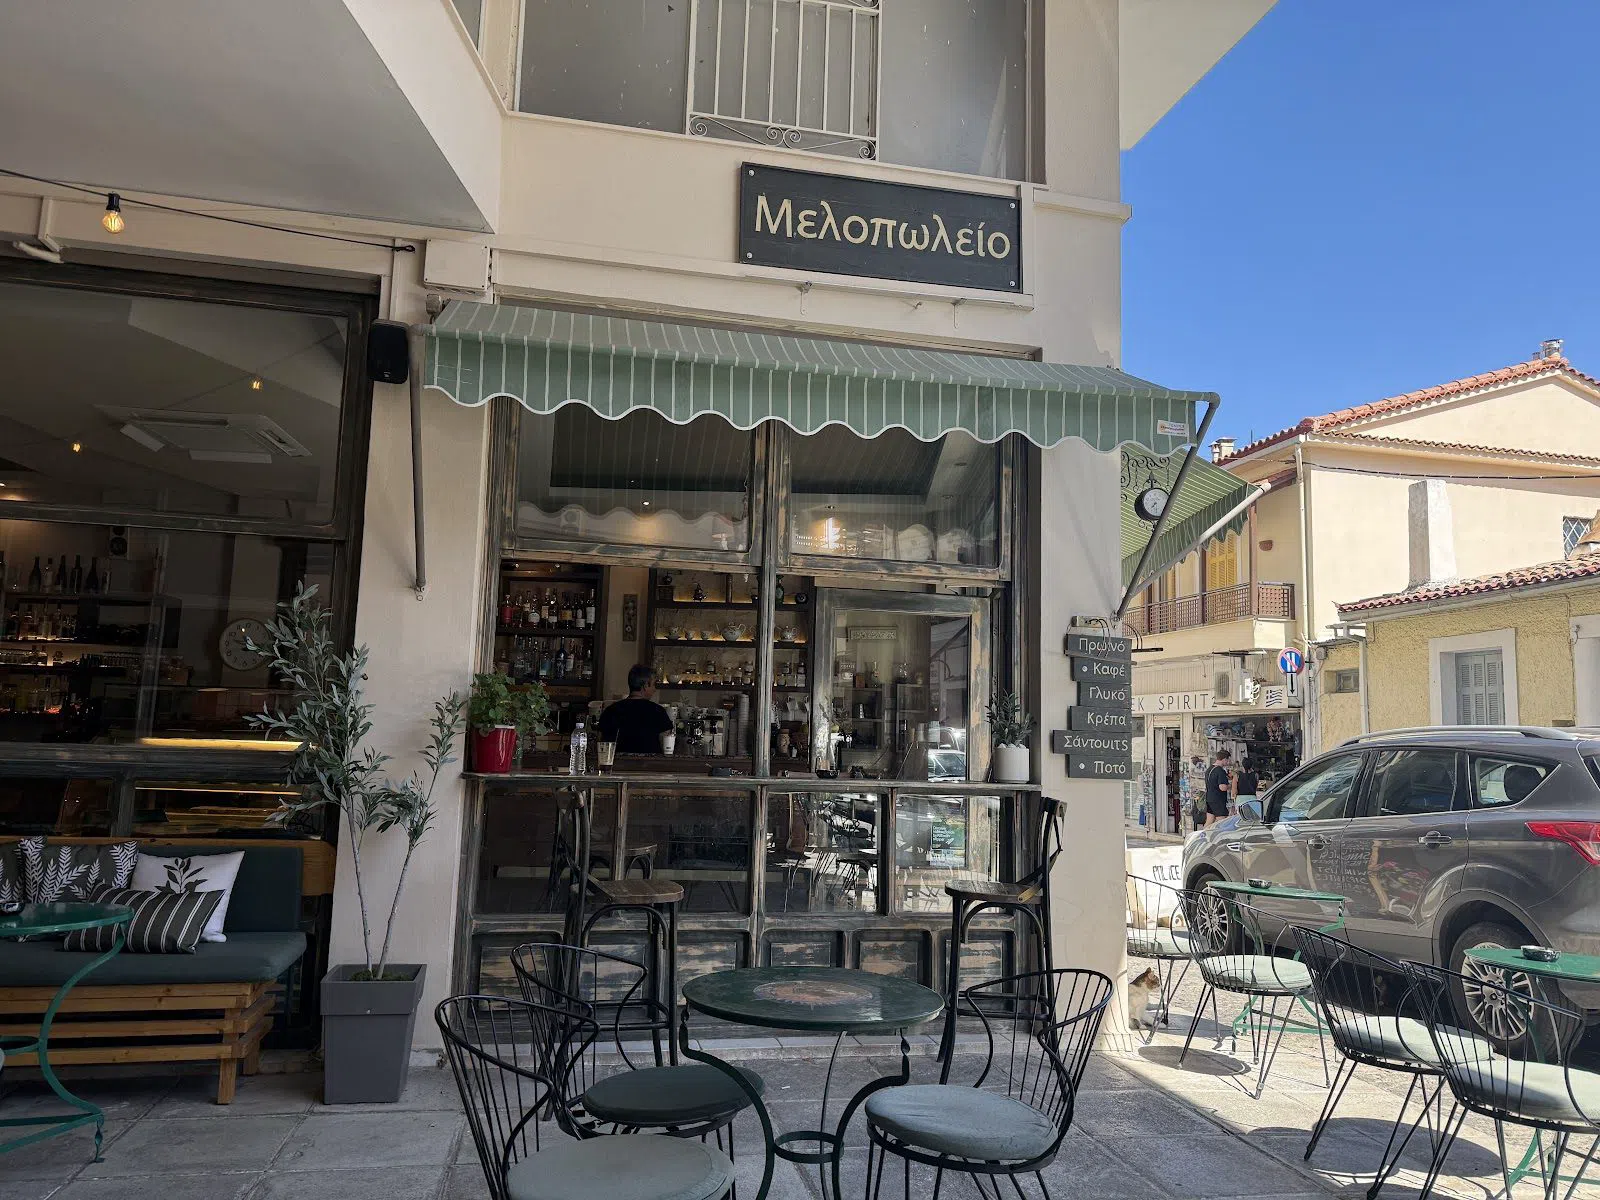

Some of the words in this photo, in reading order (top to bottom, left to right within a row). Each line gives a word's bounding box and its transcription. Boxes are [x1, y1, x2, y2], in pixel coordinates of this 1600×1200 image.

[755, 194, 1011, 259] Μελοπωλείο
[1093, 662, 1125, 678] Καφέ
[1089, 685, 1126, 701] Γλυκό
[1087, 712, 1126, 727] Κρέπα
[1094, 761, 1126, 774] Ποτό
